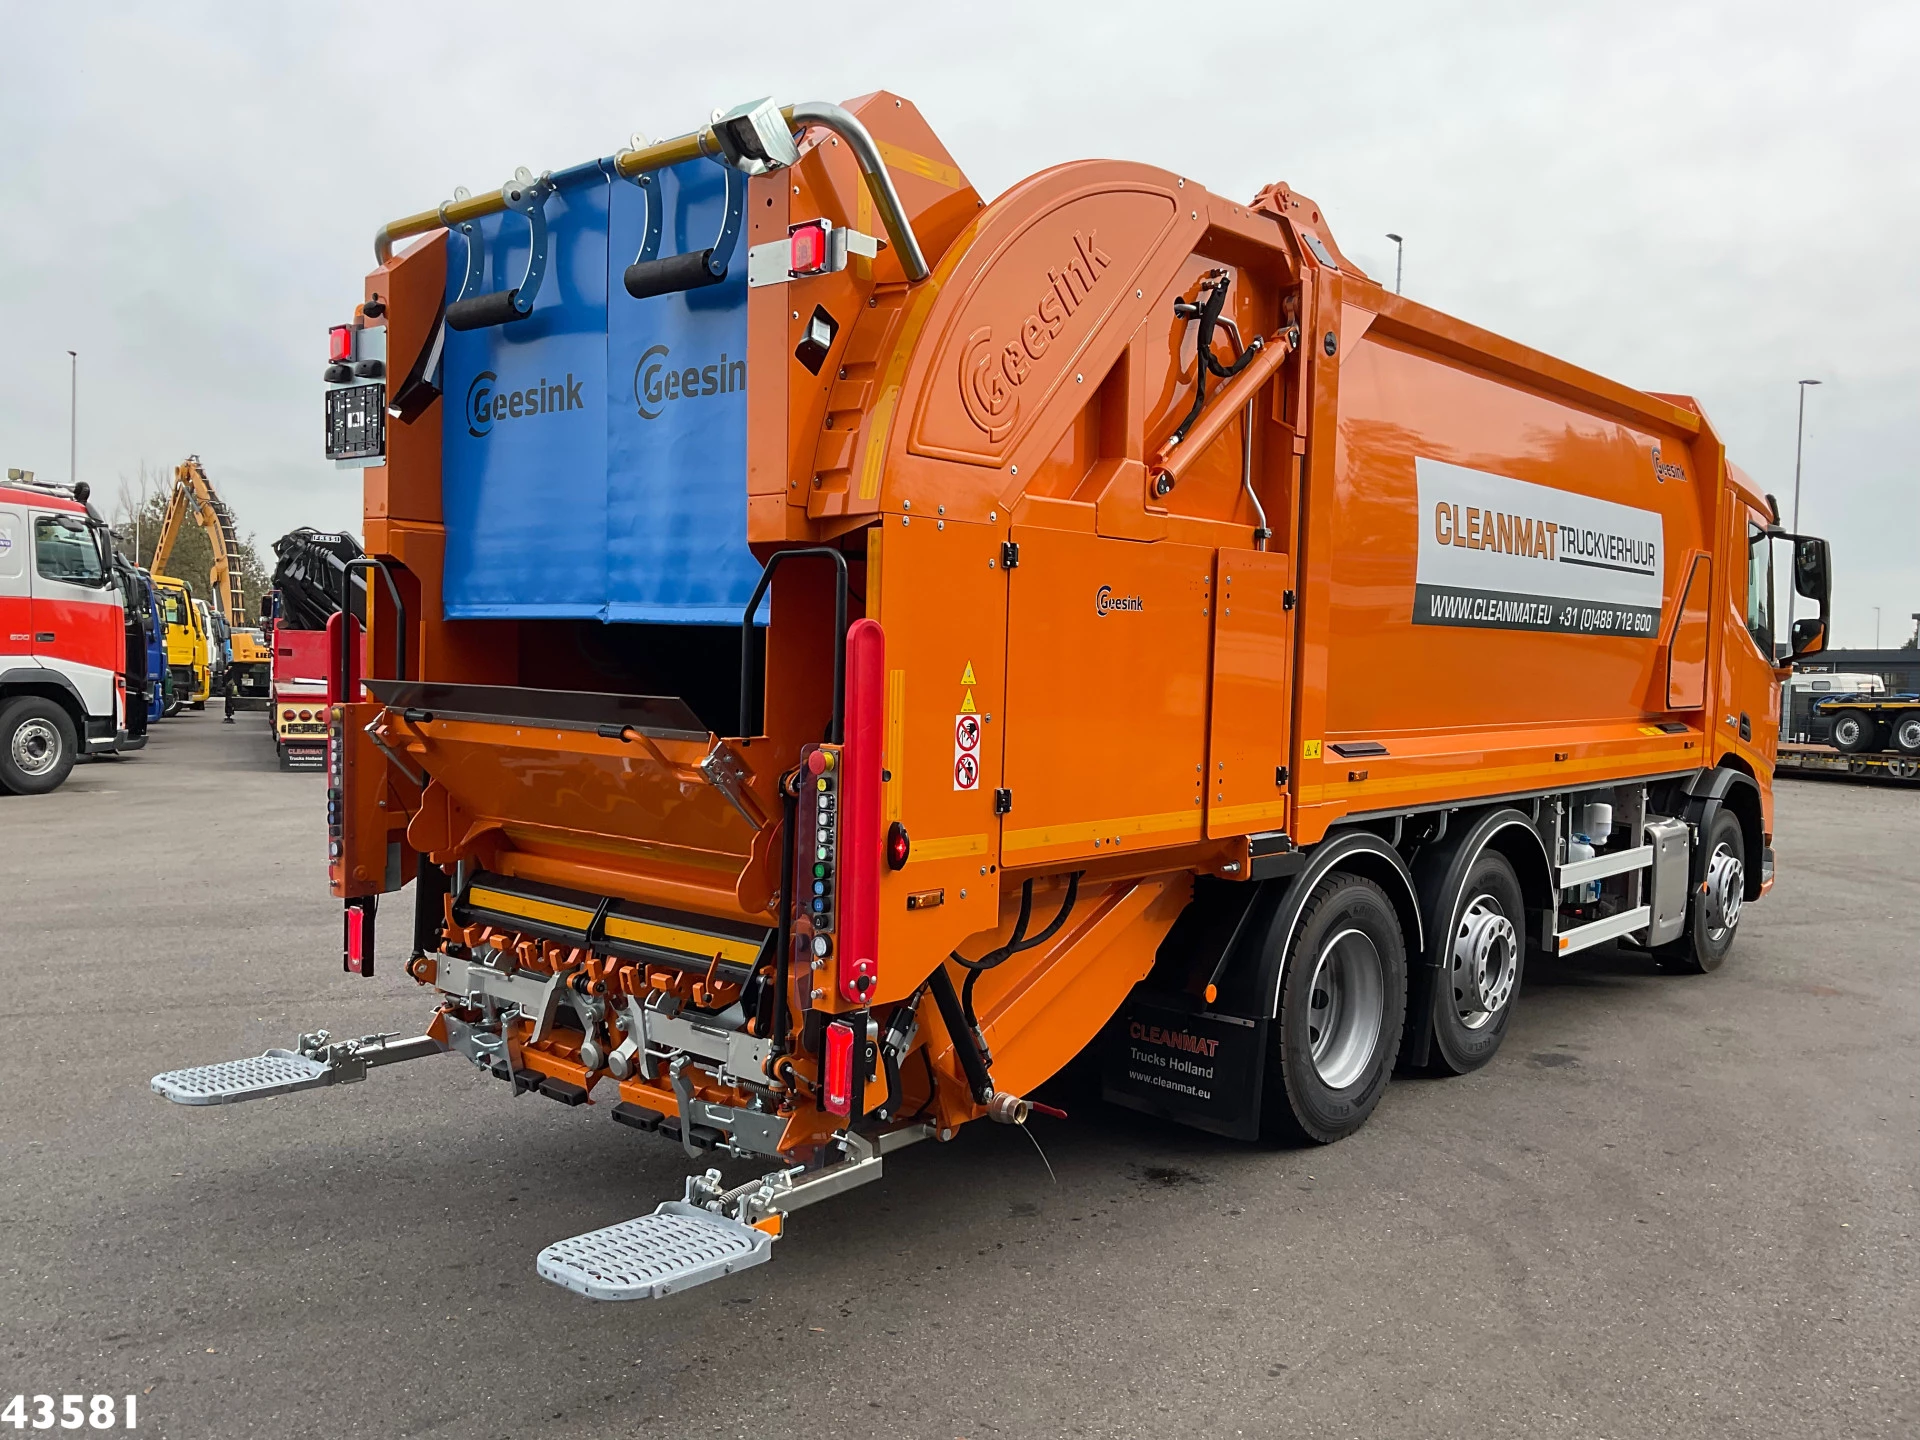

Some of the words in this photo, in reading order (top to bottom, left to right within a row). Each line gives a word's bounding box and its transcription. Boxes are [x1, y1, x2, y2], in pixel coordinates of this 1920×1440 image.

[962, 229, 1111, 435] Geesink
[637, 347, 746, 415] Geesin
[468, 372, 583, 433] Geesink
[1435, 501, 1557, 561] CLEANMAT
[1559, 525, 1655, 567] TRUCKVERHUUR
[1097, 588, 1143, 614] Geesink
[1431, 594, 1553, 625] WWW.CLEANMAT.EU
[1559, 606, 1578, 627] +31
[1580, 607, 1612, 631] (0)488
[1615, 611, 1633, 631] 712
[1635, 613, 1652, 632] 600
[1129, 1021, 1219, 1057] CLEANMAT
[1130, 1047, 1166, 1067] Trucks
[1169, 1057, 1214, 1079] Holland
[1129, 1070, 1211, 1099] www.cleanmat.eu
